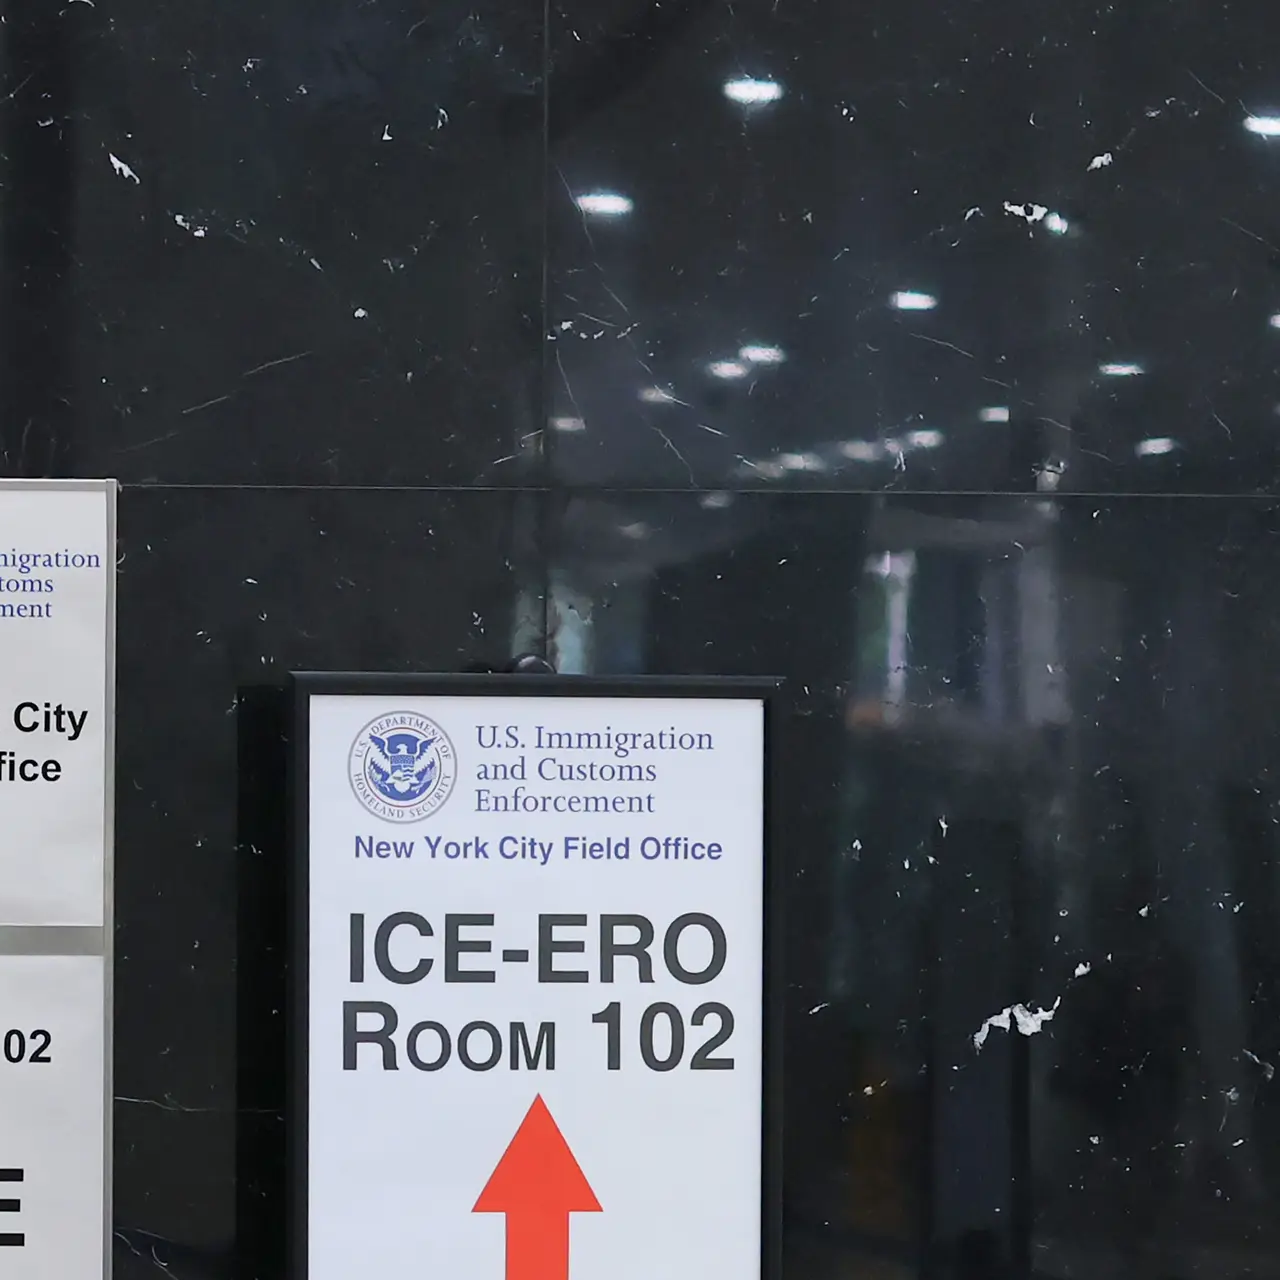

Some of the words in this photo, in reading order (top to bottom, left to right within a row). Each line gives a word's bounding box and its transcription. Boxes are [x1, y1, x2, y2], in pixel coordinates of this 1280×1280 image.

[13, 702, 88, 741] City
[371, 716, 443, 744] DEPARTMENT
[474, 726, 526, 750] U.S.
[534, 726, 714, 757] Immigration
[476, 757, 527, 781] and
[538, 758, 657, 782] Customs
[354, 772, 405, 819] HOMELAND
[409, 773, 451, 818] SECURITY
[474, 788, 655, 814] Enforcement
[354, 836, 414, 859] New
[424, 836, 489, 859] York
[499, 836, 553, 865] City
[564, 837, 630, 860] Field
[640, 837, 723, 861] Office
[349, 911, 727, 985] ICE-ERO
[592, 1001, 735, 1072] 102
